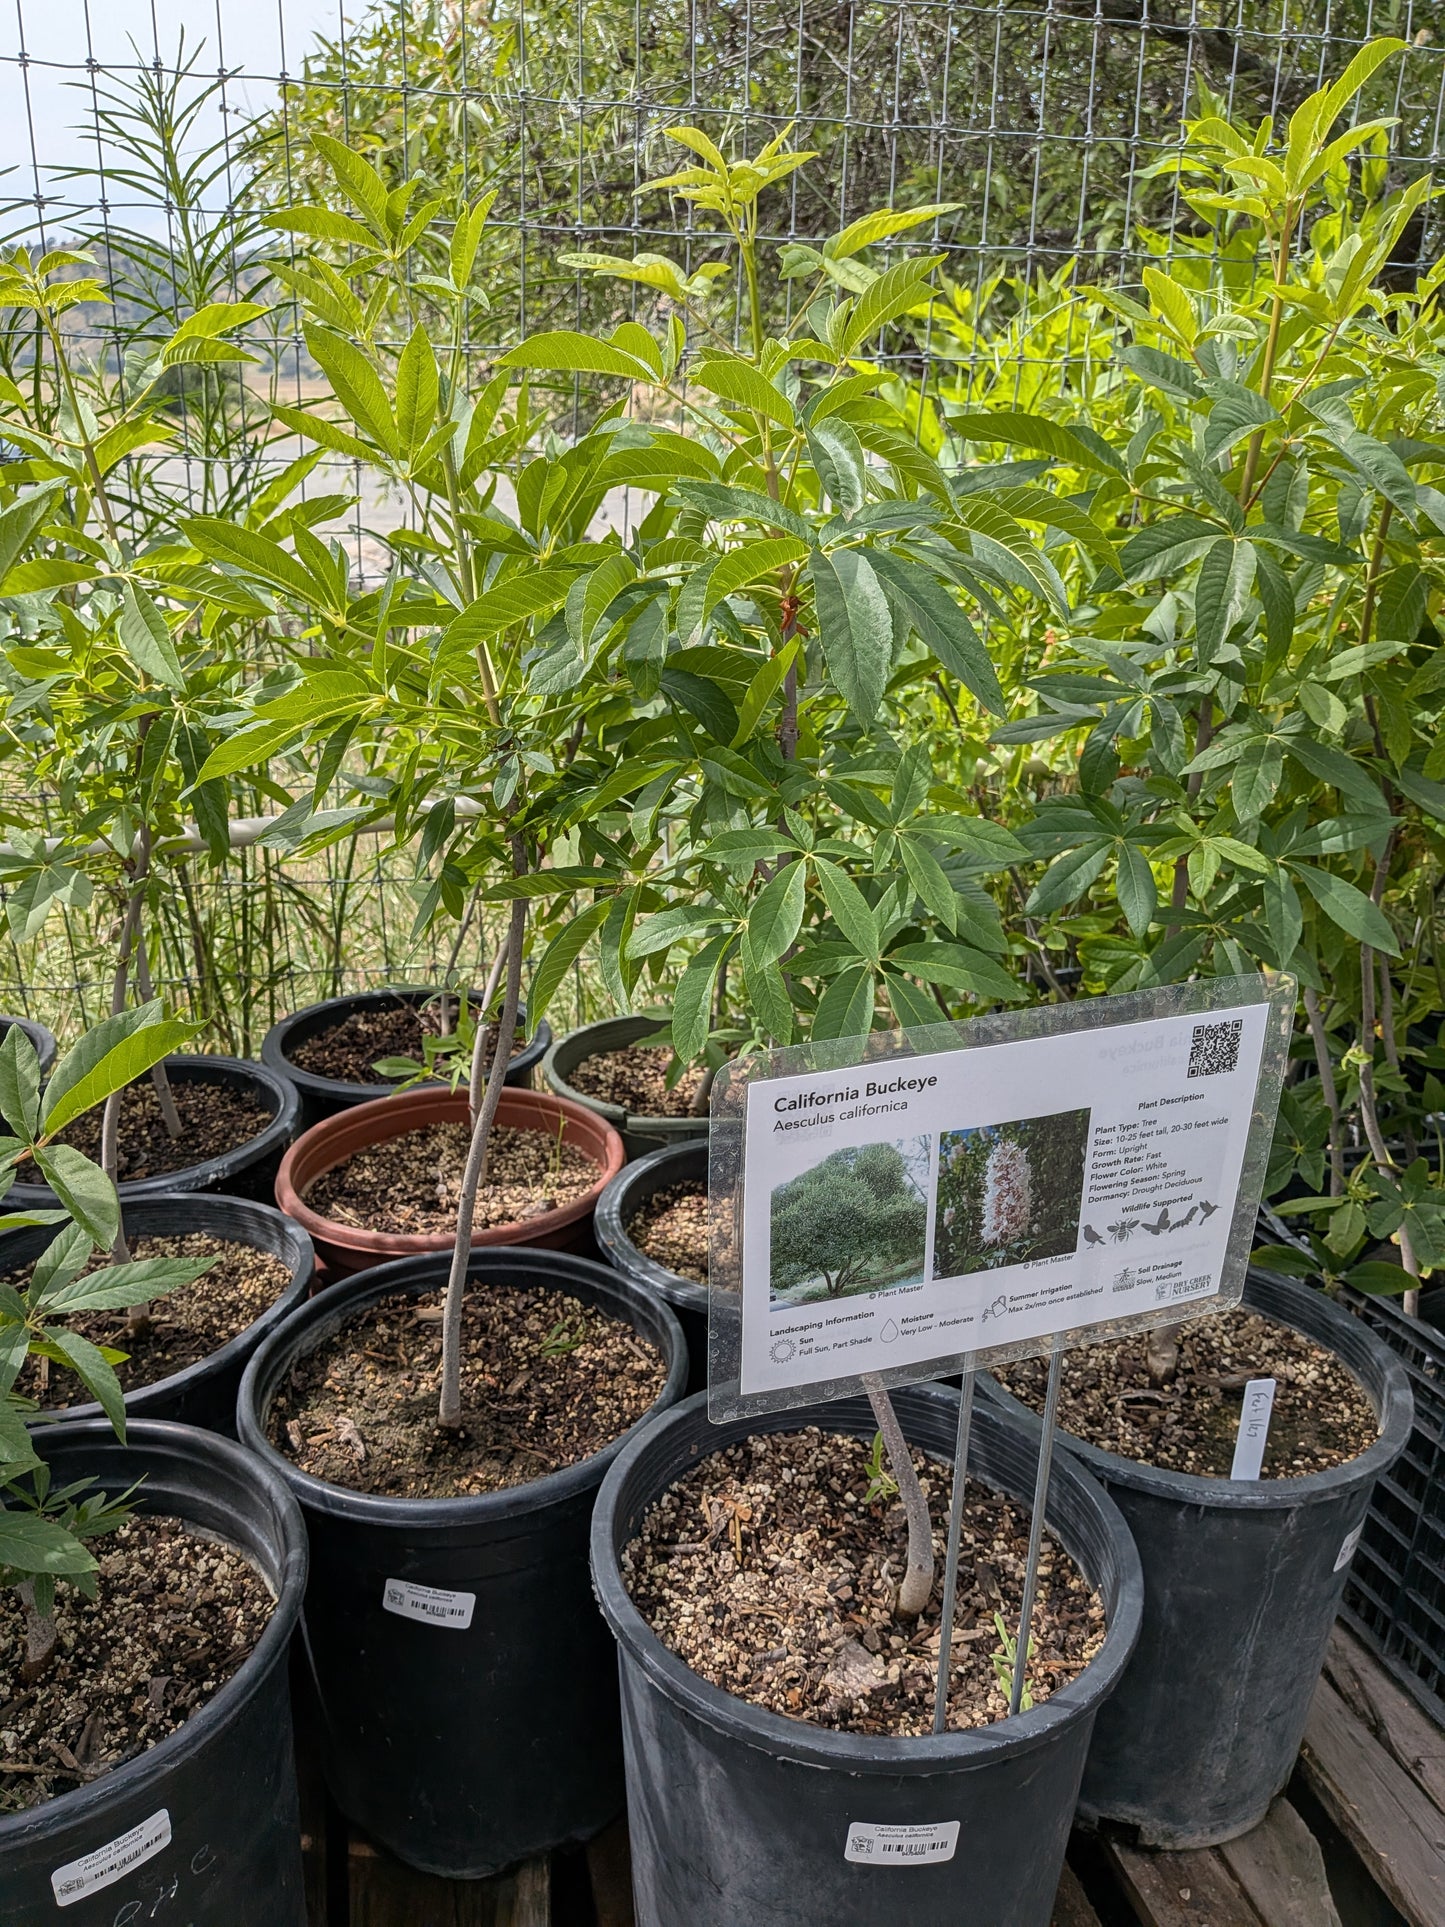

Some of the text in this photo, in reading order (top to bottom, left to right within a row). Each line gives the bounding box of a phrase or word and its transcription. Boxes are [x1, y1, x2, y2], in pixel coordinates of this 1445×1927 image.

[774, 1076, 937, 1112] California Buckeye
[1138, 1093, 1205, 1111] Plant Description
[773, 1100, 908, 1132] Aesculus californica
[1093, 1117, 1229, 1147] Size: 10-25 feet tall, 20-30 feet wide
[1095, 1119, 1157, 1135] Plant Type: Tree
[1092, 1143, 1148, 1158] Form: Upright
[1091, 1152, 1162, 1170] Growth Rate: Fast
[1089, 1169, 1186, 1192] Flowering Season: Spring
[1090, 1162, 1167, 1181] Flower Color: White
[1088, 1177, 1203, 1203] Dormancy: Drought Deciduous
[1122, 1193, 1193, 1214] Wildlife Supported
[1031, 1259, 1049, 1269] Plant
[1050, 1255, 1074, 1265] Master
[1138, 1260, 1183, 1275] Soil Drainage
[1136, 1271, 1182, 1286] Slow, Medium
[1172, 1280, 1211, 1296] NURSERY
[1173, 1274, 1212, 1289] DRY CREEK
[878, 1288, 897, 1299] Plant
[899, 1285, 924, 1295] Master
[1008, 1286, 1104, 1314] Max 2x/mo once established
[1009, 1283, 1073, 1302] Summer Irrigation
[770, 1312, 875, 1337] Landscaping Information
[900, 1328, 917, 1338] Very
[918, 1324, 933, 1333] Low
[938, 1315, 974, 1328] Moderate
[901, 1312, 934, 1324] Moisture
[799, 1337, 814, 1345] Sun
[799, 1336, 873, 1356] Full Sun, Part Shade
[909, 1825, 938, 1833] Buckeye
[77, 1845, 113, 1867] California
[114, 1825, 145, 1849] Buckeye
[83, 1854, 112, 1872] Aesculus
[112, 1834, 143, 1855] californica
